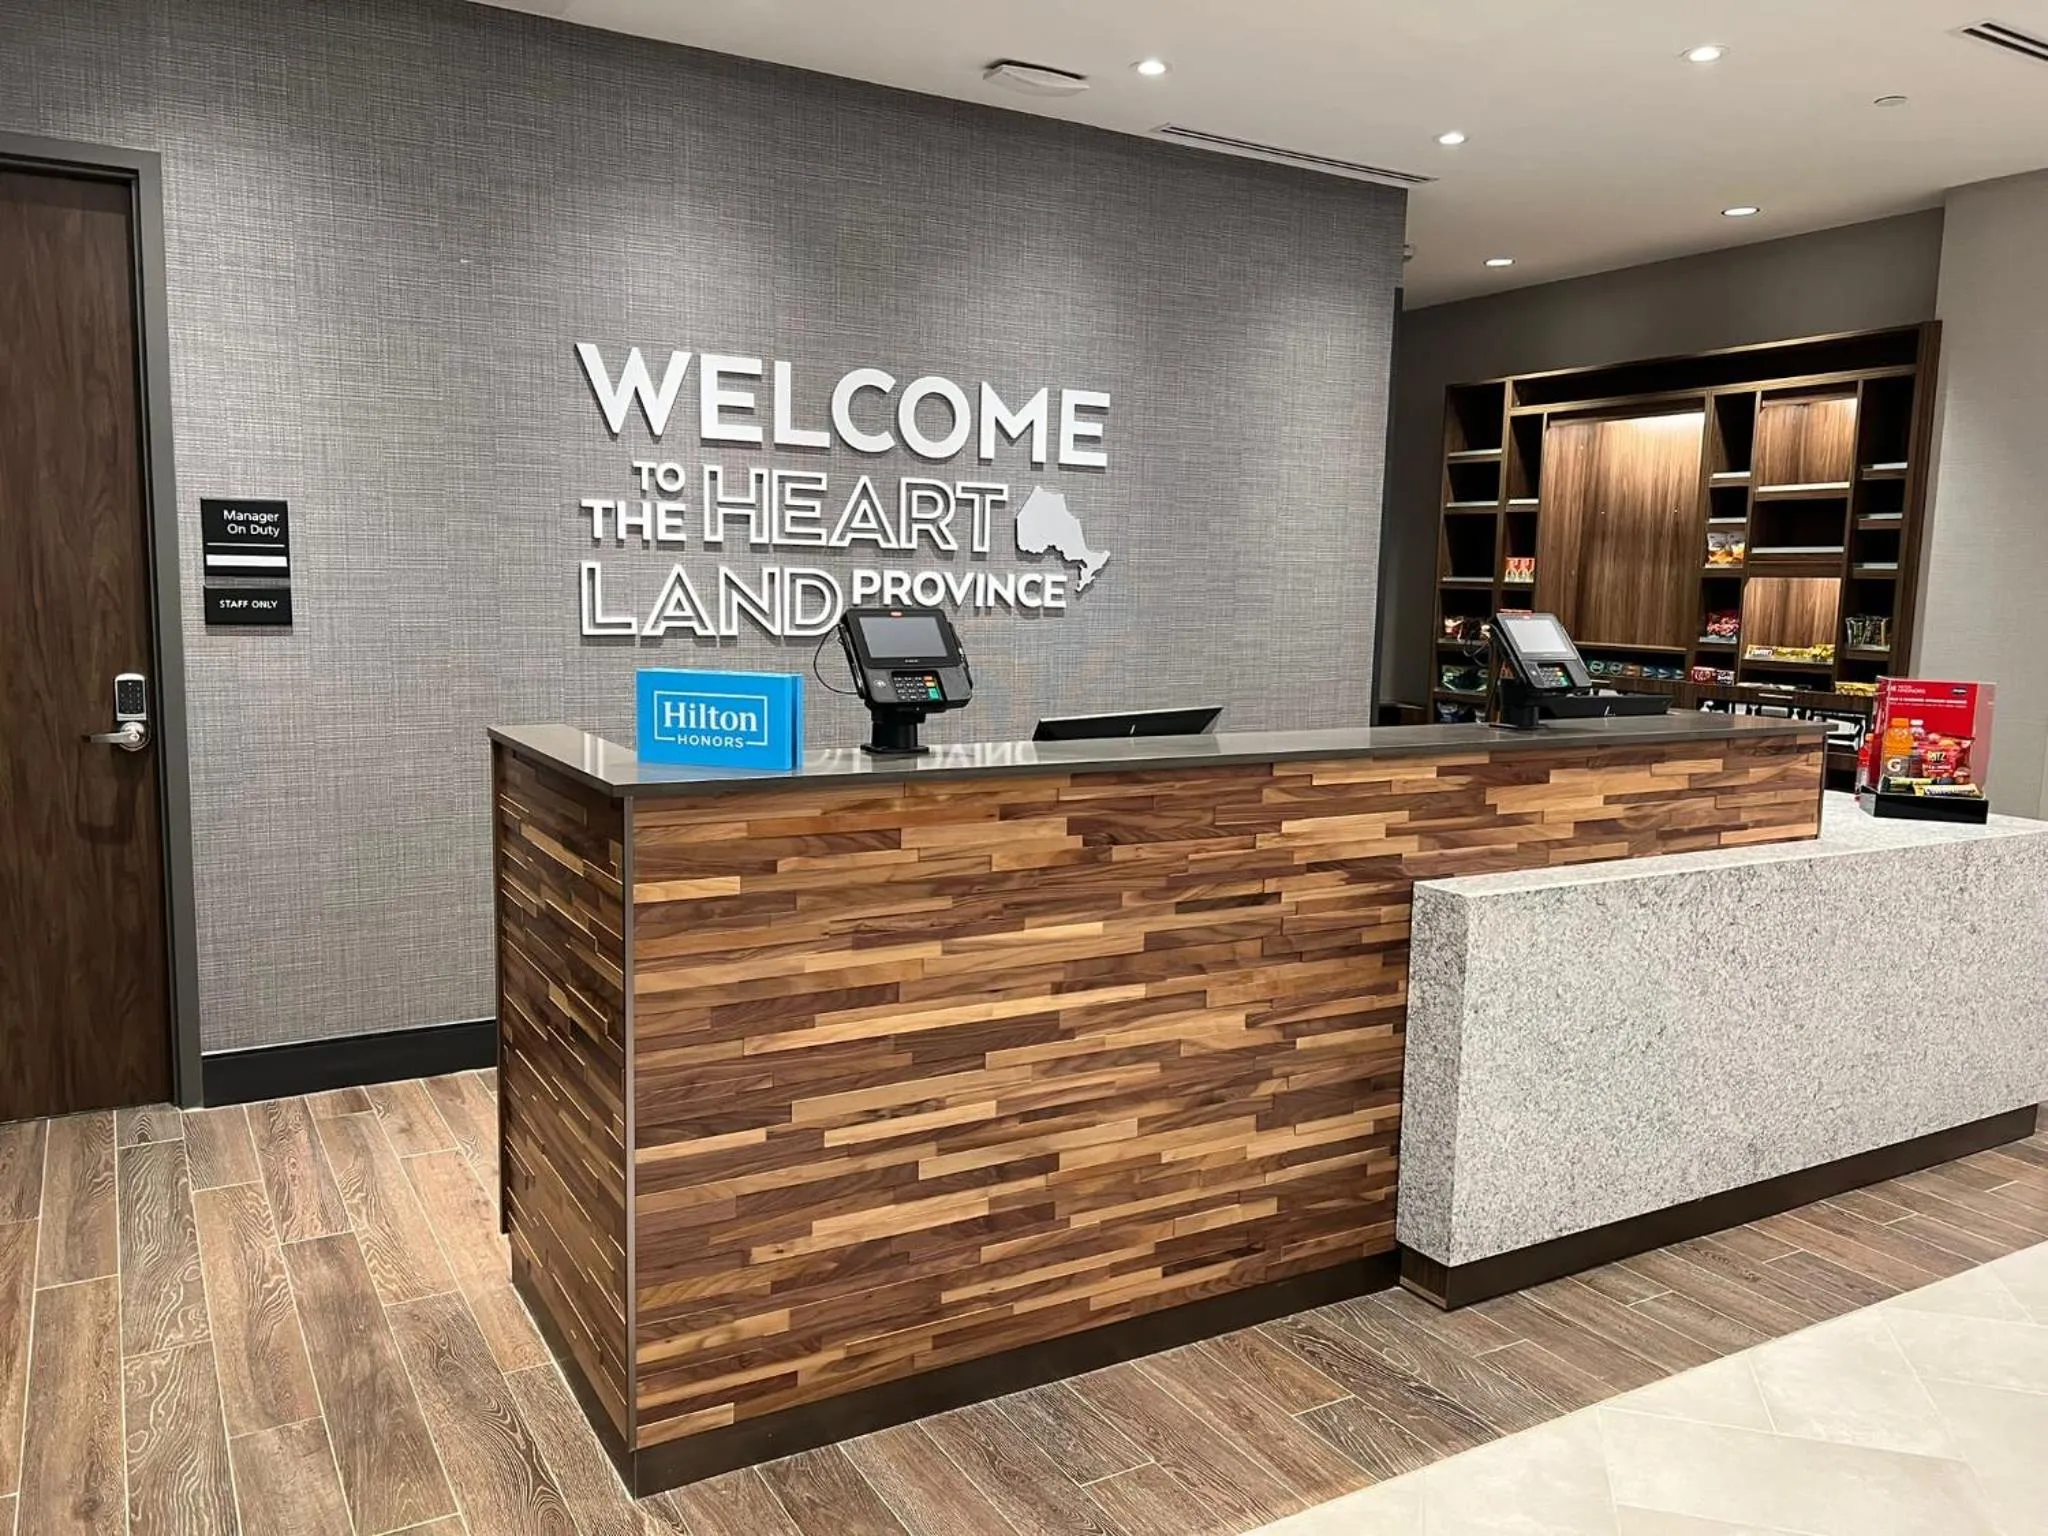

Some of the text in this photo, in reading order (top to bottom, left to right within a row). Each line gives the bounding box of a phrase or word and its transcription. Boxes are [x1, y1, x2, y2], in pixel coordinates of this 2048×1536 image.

[575, 342, 1111, 468] WELCOME
[632, 460, 686, 492] TO
[223, 509, 280, 524] Manager
[581, 463, 1009, 553] THE HEART
[226, 523, 281, 538] On Duty
[219, 599, 278, 609] STAFF ONLY
[580, 560, 1068, 636] LAND PROVINCE
[663, 701, 758, 732] Hilton
[677, 734, 745, 748] HONORS
